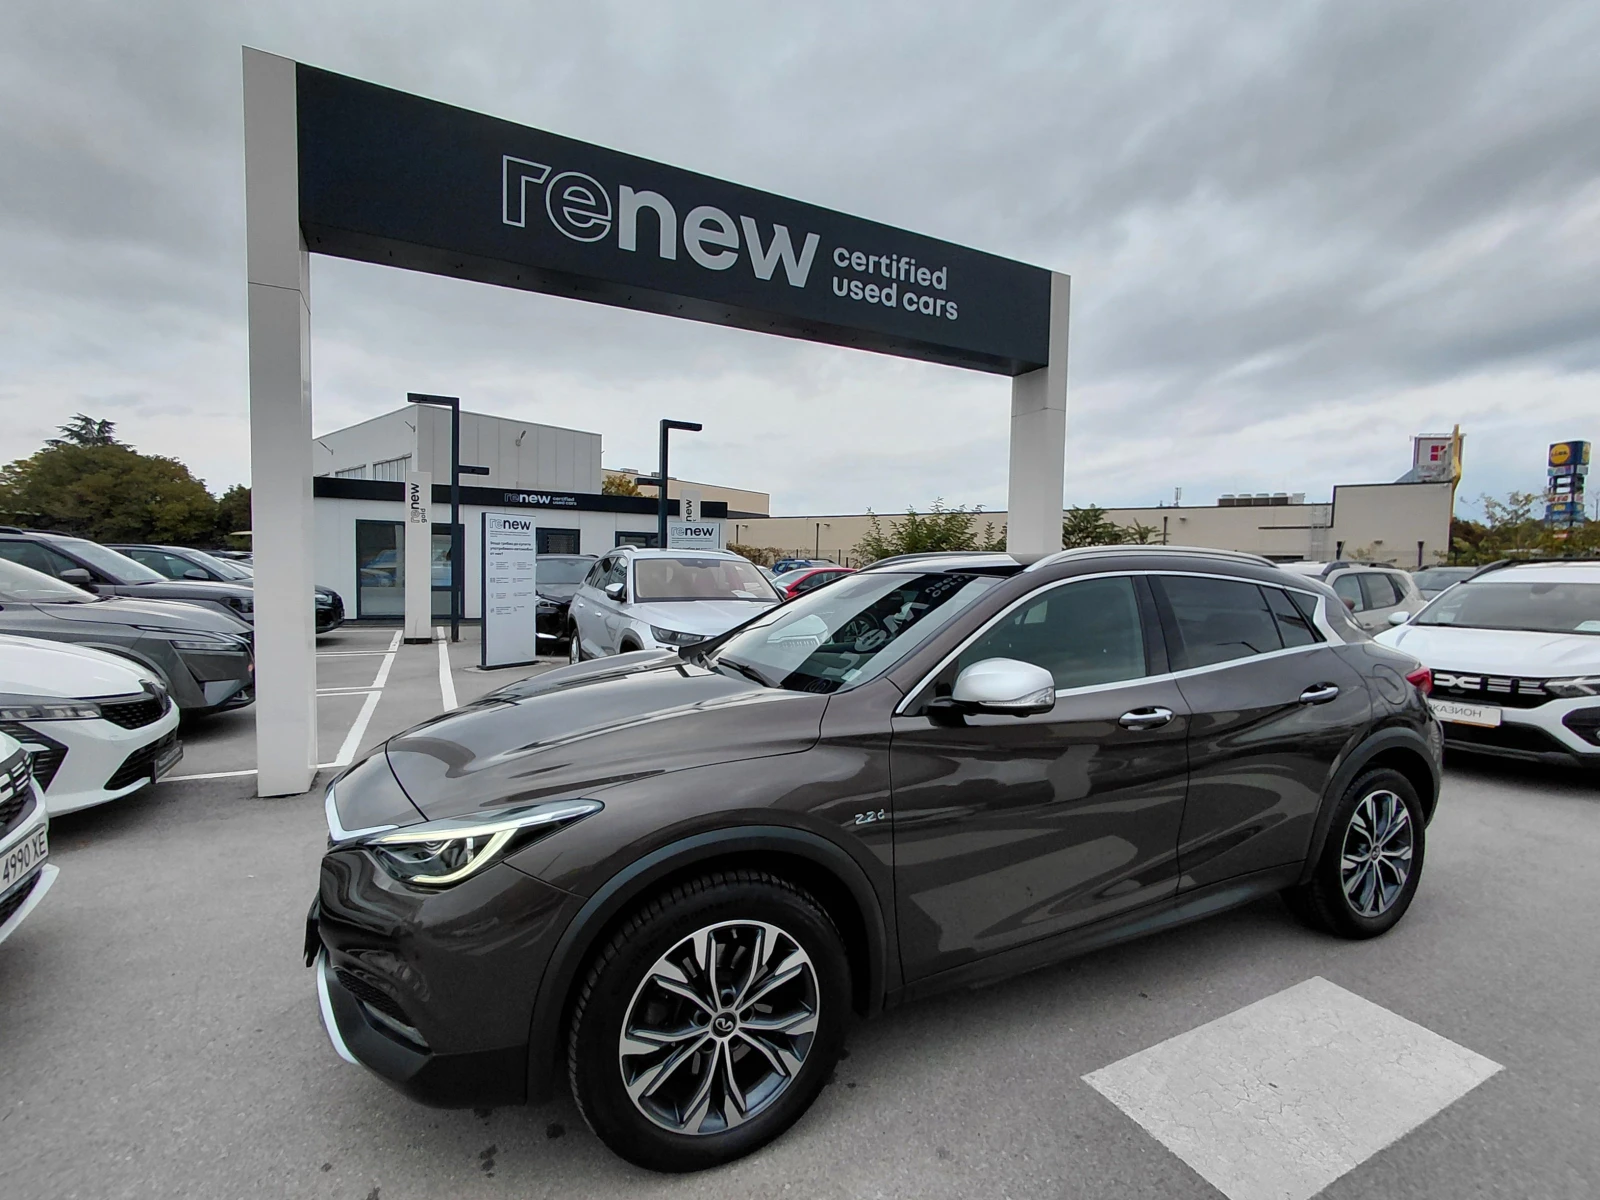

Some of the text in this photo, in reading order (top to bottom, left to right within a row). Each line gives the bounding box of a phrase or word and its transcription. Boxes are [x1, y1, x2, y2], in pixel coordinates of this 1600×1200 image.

[501, 153, 821, 289] renew
[832, 246, 948, 291] certified
[832, 275, 960, 321] used cars
[410, 482, 420, 524] renew
[504, 492, 552, 505] renew
[685, 499, 693, 522] new
[419, 507, 428, 524] gold
[489, 518, 532, 531] renew
[670, 526, 715, 537] renew
[2, 830, 48, 884] 4990 XE
